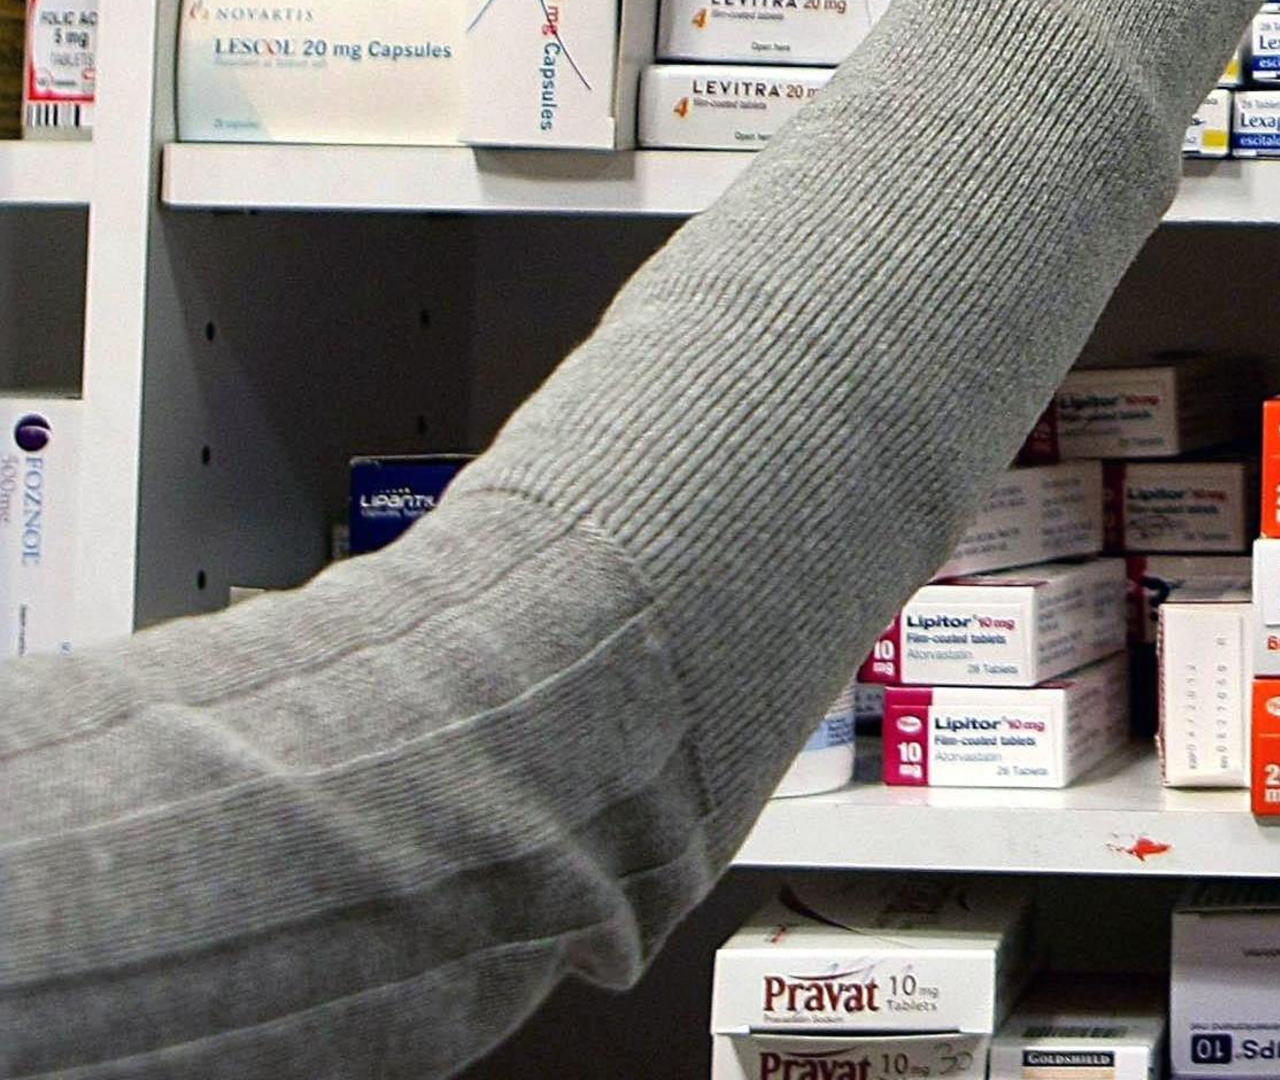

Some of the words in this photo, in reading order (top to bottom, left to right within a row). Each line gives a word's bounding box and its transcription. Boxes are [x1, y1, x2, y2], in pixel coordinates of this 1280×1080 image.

[824, 0, 847, 13] mg
[23, 456, 44, 565] FOZNOL
[907, 615, 971, 629] Lipitor
[764, 976, 880, 1012] Pravat
[888, 974, 917, 997] 10
